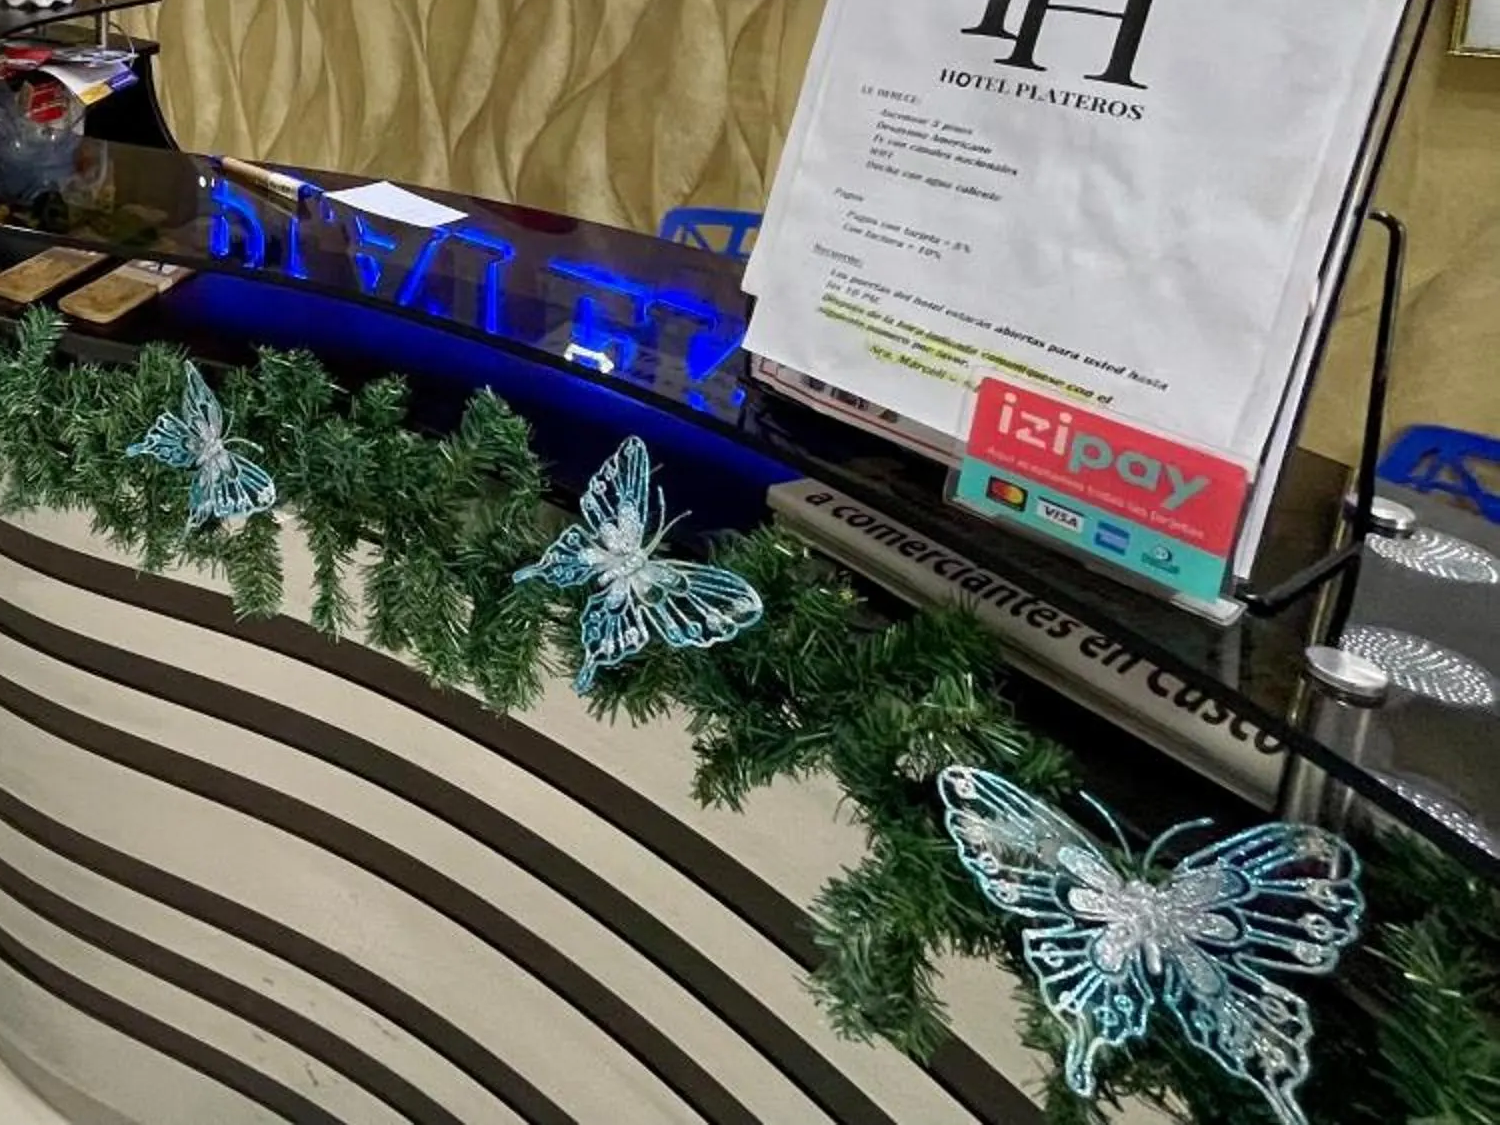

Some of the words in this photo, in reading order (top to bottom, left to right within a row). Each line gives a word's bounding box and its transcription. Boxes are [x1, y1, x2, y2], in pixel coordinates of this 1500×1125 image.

[940, 68, 1010, 95] HOTEL
[1015, 81, 1145, 121] PLATEROS
[913, 296, 946, 313] hotel
[994, 325, 1045, 348] abiertas
[1047, 343, 1081, 361] para
[1083, 355, 1127, 376] usted
[1127, 369, 1170, 393] hasta
[997, 391, 1211, 511] izipay
[1043, 504, 1079, 528] VISA
[805, 491, 834, 506] a
[832, 505, 1081, 639] comerciantes
[1080, 635, 1144, 674] en
